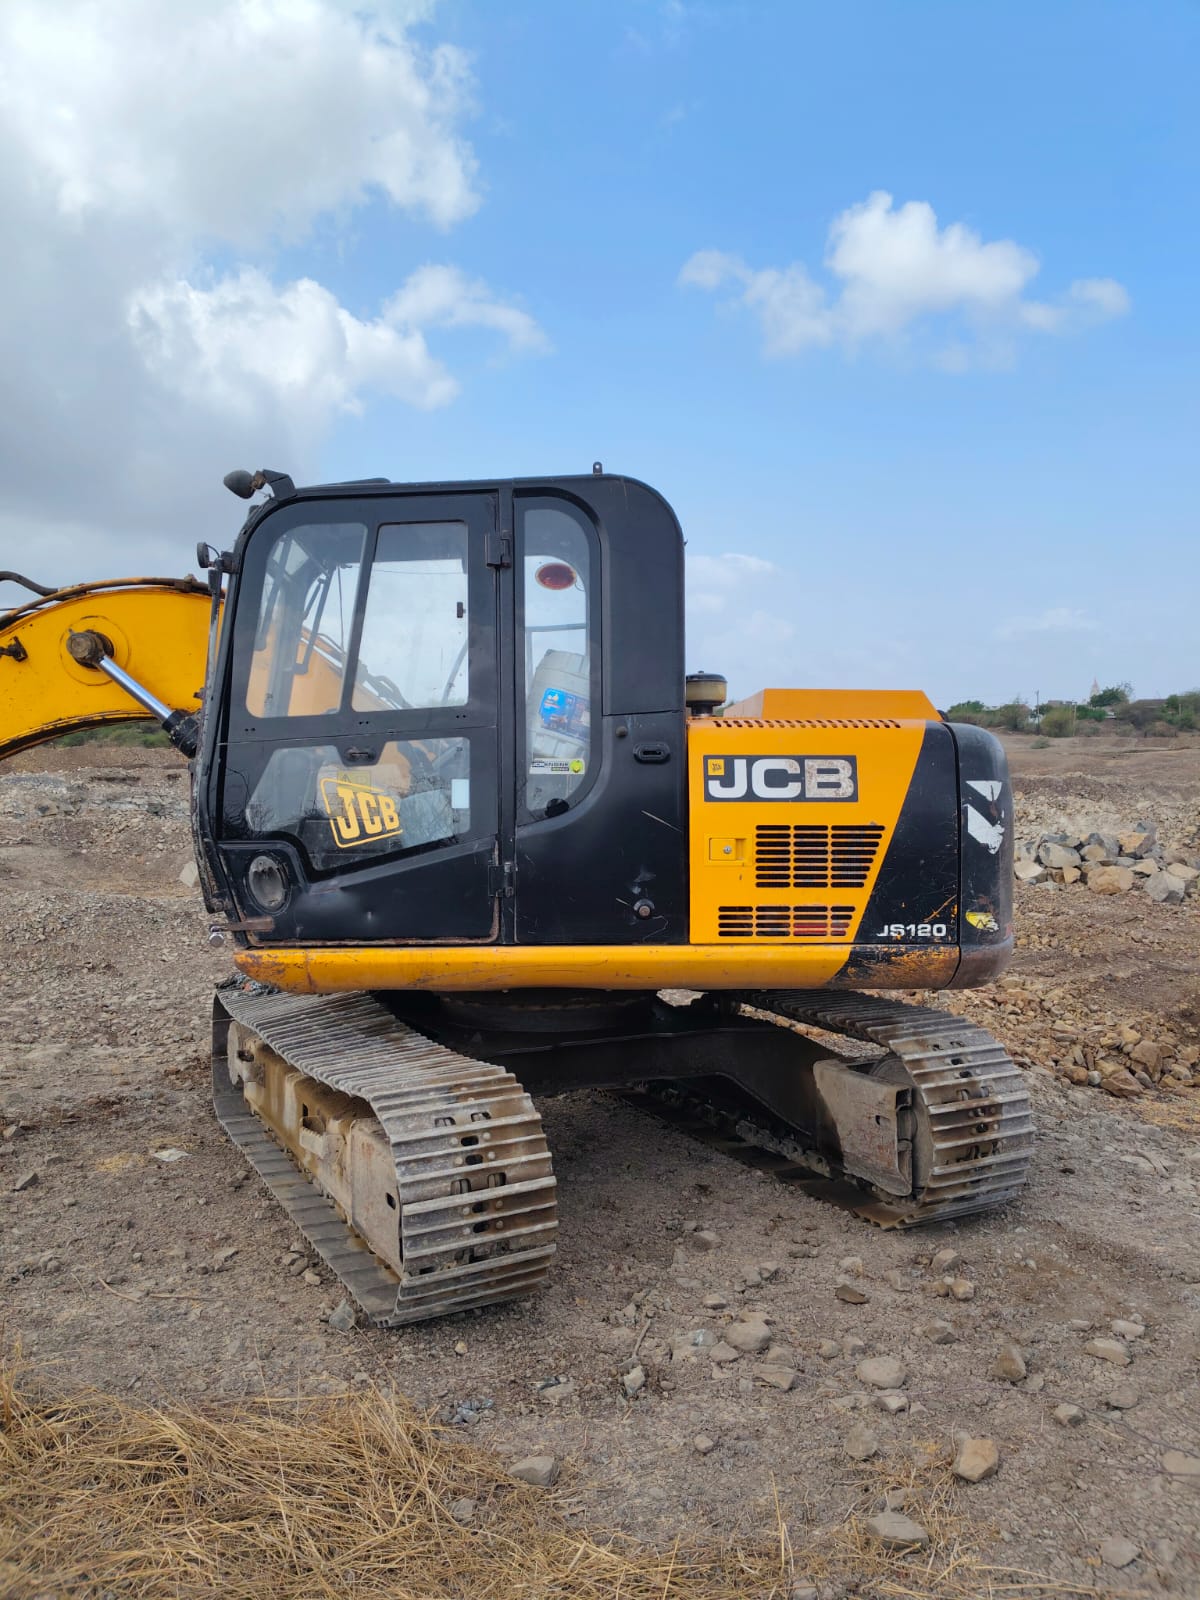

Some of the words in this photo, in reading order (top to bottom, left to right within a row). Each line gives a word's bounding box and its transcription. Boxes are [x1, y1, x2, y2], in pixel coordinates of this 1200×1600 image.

[708, 758, 855, 799] JCB
[336, 786, 400, 839] JCB
[876, 923, 947, 938] JS120
